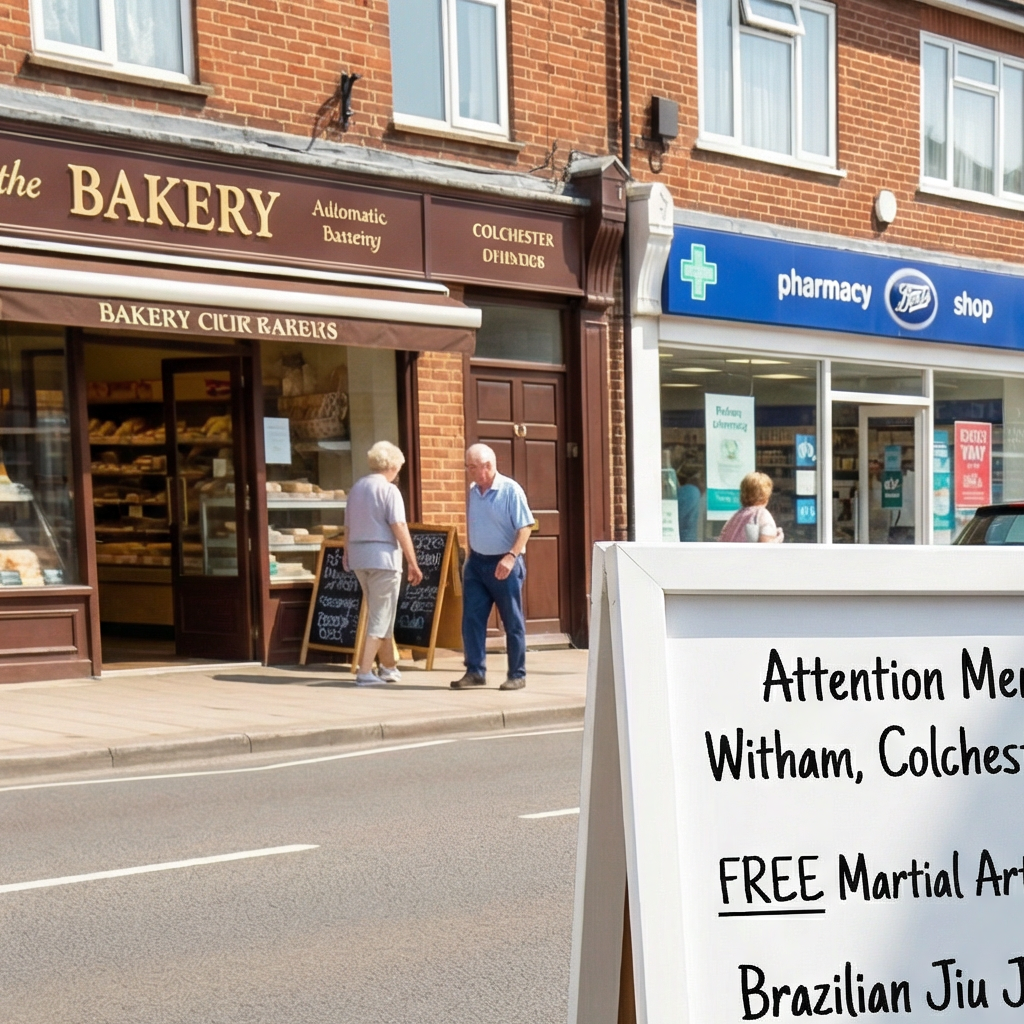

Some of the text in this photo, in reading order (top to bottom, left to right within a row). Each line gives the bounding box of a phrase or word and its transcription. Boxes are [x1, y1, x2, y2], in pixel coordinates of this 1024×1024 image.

[0, 159, 281, 239] the BAKERY
[472, 223, 555, 248] COLCHESTER
[98, 302, 190, 330] BAKERY
[777, 268, 872, 310] pharmacy
[953, 290, 993, 324] shop
[762, 647, 946, 704] Attention
[704, 727, 865, 786] Witham,
[719, 855, 826, 910] FREE
[838, 850, 965, 902] Martial
[737, 961, 912, 1022] Brazilian
[925, 958, 990, 1013] Jiu
